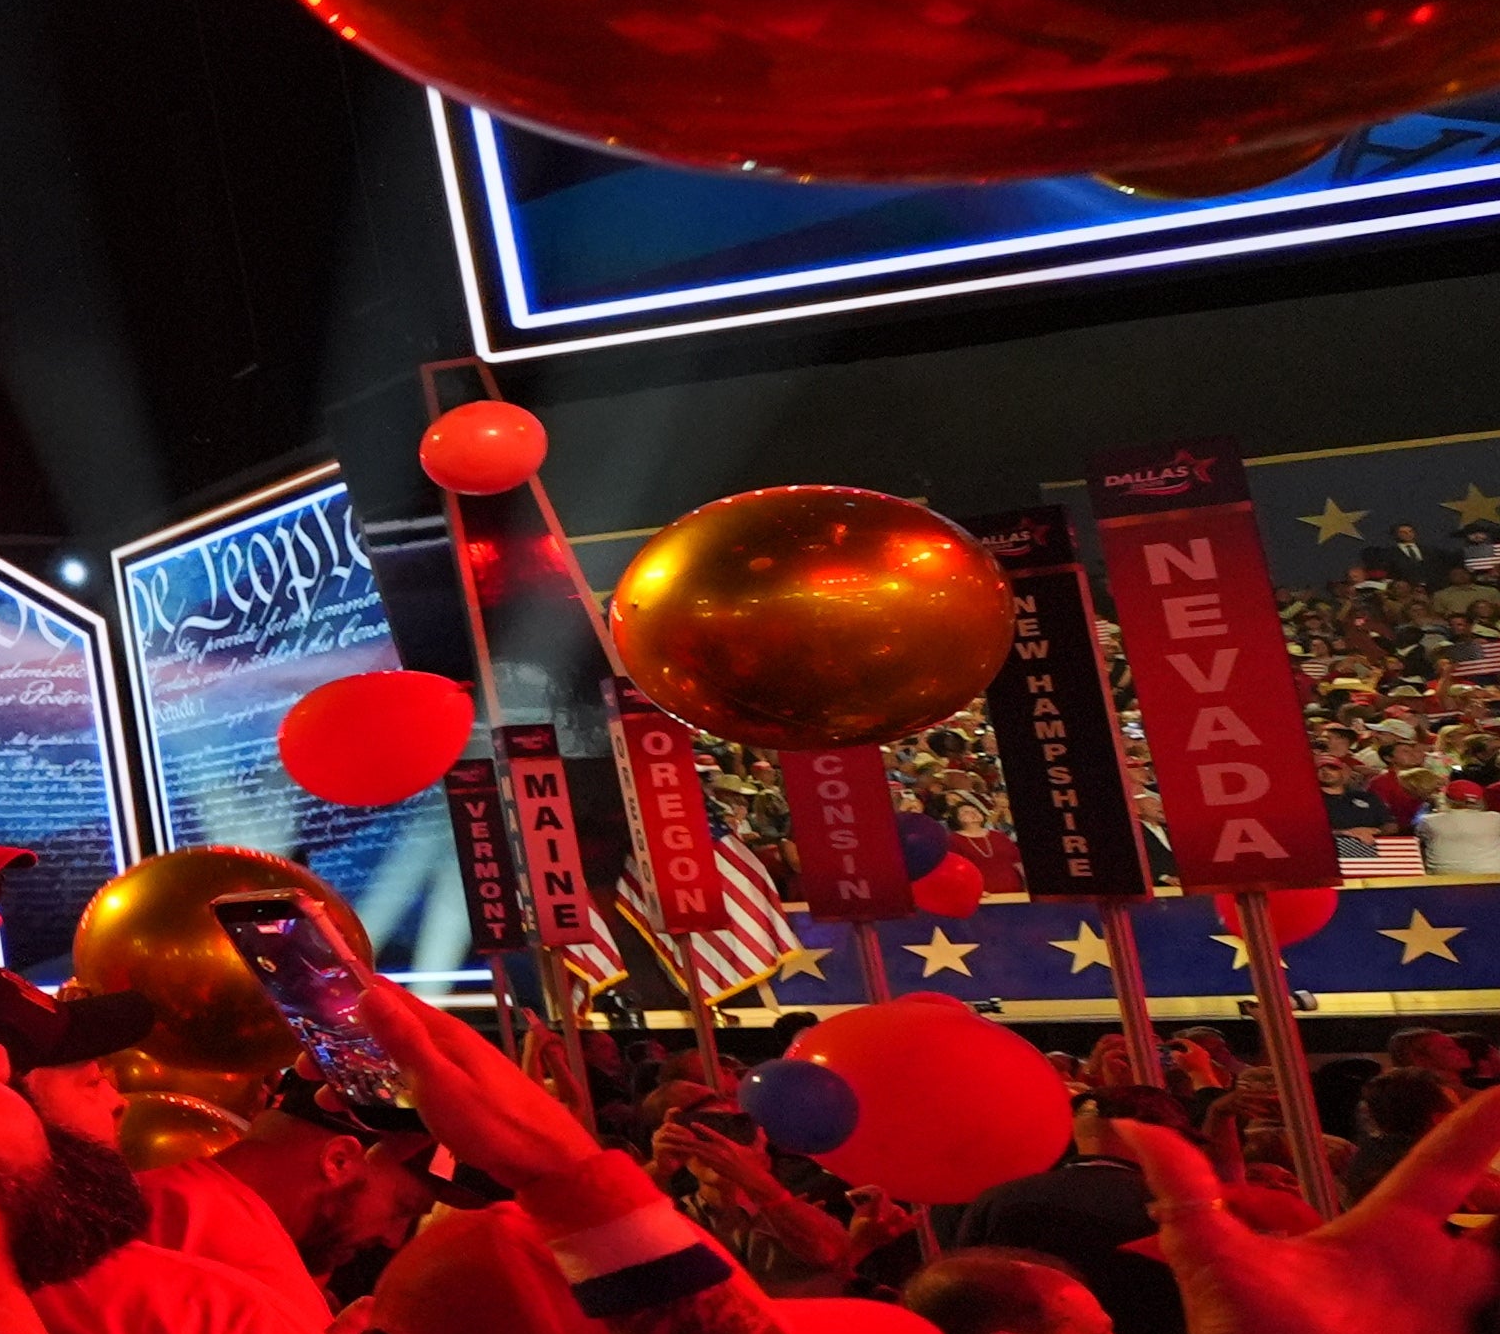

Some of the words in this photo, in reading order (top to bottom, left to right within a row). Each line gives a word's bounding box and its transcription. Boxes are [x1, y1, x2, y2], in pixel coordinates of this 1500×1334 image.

[981, 530, 1032, 545] ALLAS
[1104, 465, 1190, 488] DALLAS
[1014, 595, 1049, 659] NEW
[1142, 536, 1291, 864] NEVADA
[641, 730, 708, 914] OREGON
[812, 754, 872, 900] CONSIN
[1026, 673, 1094, 878] HAMPSHIRE
[465, 801, 507, 940] VERMONT
[523, 773, 581, 929] MAINE
